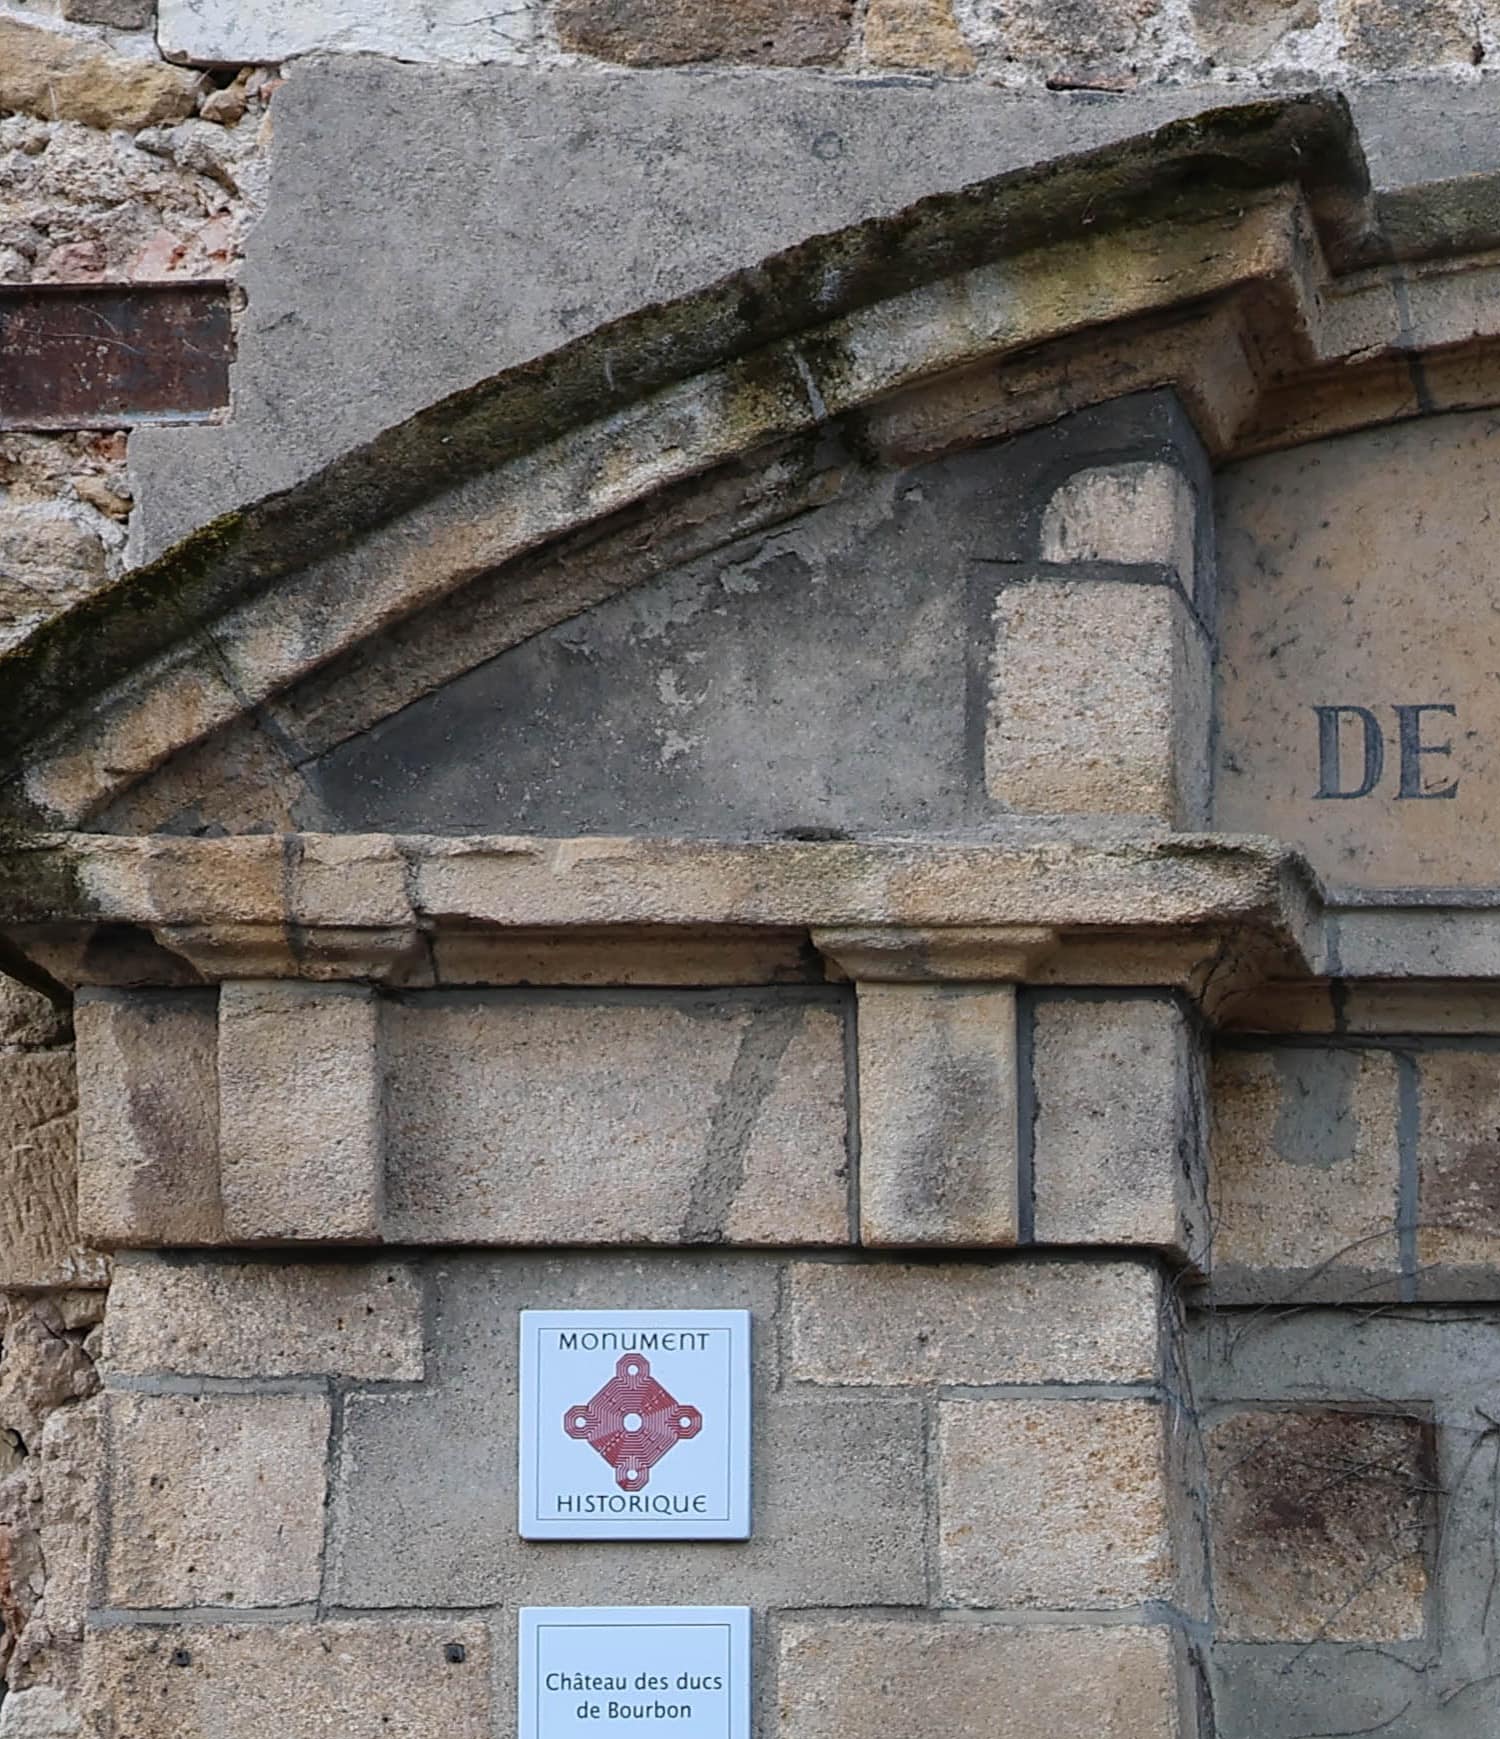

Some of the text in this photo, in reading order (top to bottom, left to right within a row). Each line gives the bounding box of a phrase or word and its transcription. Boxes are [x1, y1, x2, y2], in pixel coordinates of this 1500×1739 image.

[1312, 703, 1460, 801] DE
[557, 1494, 708, 1516] HISTORIQUE
[545, 1672, 722, 1691] Château des ducs
[576, 1700, 692, 1719] de Bourbon
